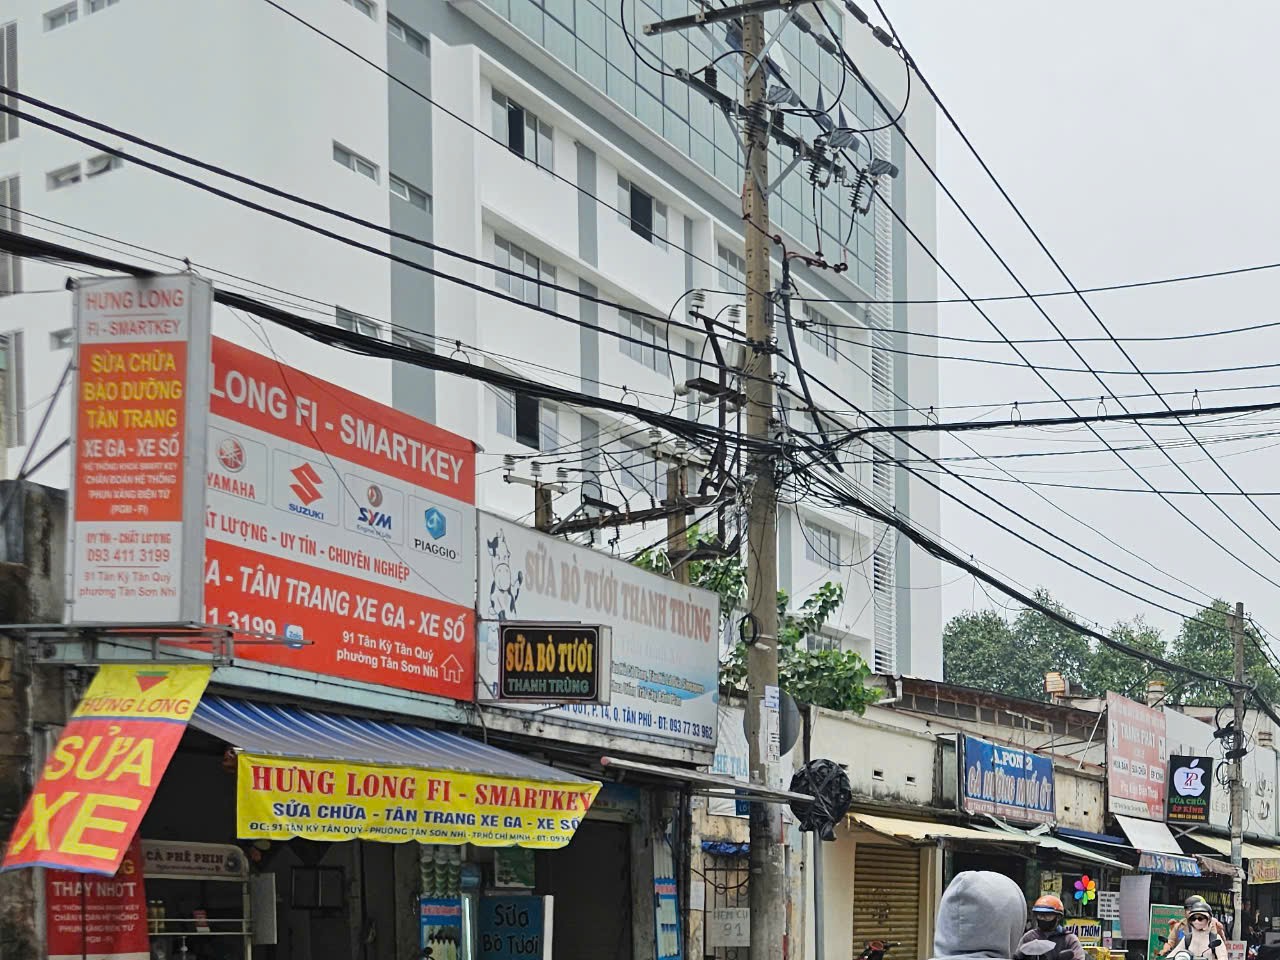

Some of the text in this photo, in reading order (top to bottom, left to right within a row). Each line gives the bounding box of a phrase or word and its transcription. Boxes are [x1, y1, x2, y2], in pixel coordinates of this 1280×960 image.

[138, 288, 184, 309] LONG
[110, 319, 180, 336] SMARTKEY
[122, 408, 177, 428] TRANG
[83, 432, 180, 457] XE GA XE SỐ
[296, 399, 318, 433] FI
[340, 414, 464, 485] SMARTKEY
[207, 473, 256, 500] YAMAHA
[288, 503, 324, 521] SUZUKI
[358, 507, 392, 530] SYM
[87, 549, 169, 562] 093 411 3199
[221, 515, 410, 583] LƯỢNG UY TÍN CHUYÊN NGHIỆP
[414, 538, 457, 560] PIAGGIO
[240, 565, 466, 643] TÂN TRANG XE GA XE SỐ
[620, 582, 668, 630] THANH
[343, 630, 354, 643] 91
[358, 633, 376, 648] Tân
[395, 641, 413, 656] Tân
[415, 645, 434, 661] Quý
[506, 633, 534, 672] SỮA
[537, 633, 556, 673] BÒ
[558, 637, 594, 674] TƯƠI
[337, 649, 378, 669] phường
[381, 657, 399, 671] Tân
[401, 661, 421, 675] Sơn
[508, 678, 547, 693] THANH
[622, 708, 636, 724] TÂN
[670, 718, 682, 733] 093
[683, 720, 692, 735] 77
[692, 722, 702, 737] 33
[701, 724, 713, 740] 962
[43, 725, 155, 787] SỬA
[251, 765, 593, 811] HƯNG LONG FI SMARTKEY
[10, 792, 142, 861] XE
[273, 799, 311, 817] SỬA
[317, 803, 366, 819] CHỮA
[385, 806, 418, 822] TÂN
[424, 810, 476, 825] TRANG
[481, 814, 499, 827] XE
[503, 816, 522, 828] GA
[537, 818, 555, 830] XE
[322, 825, 341, 833] TÂN
